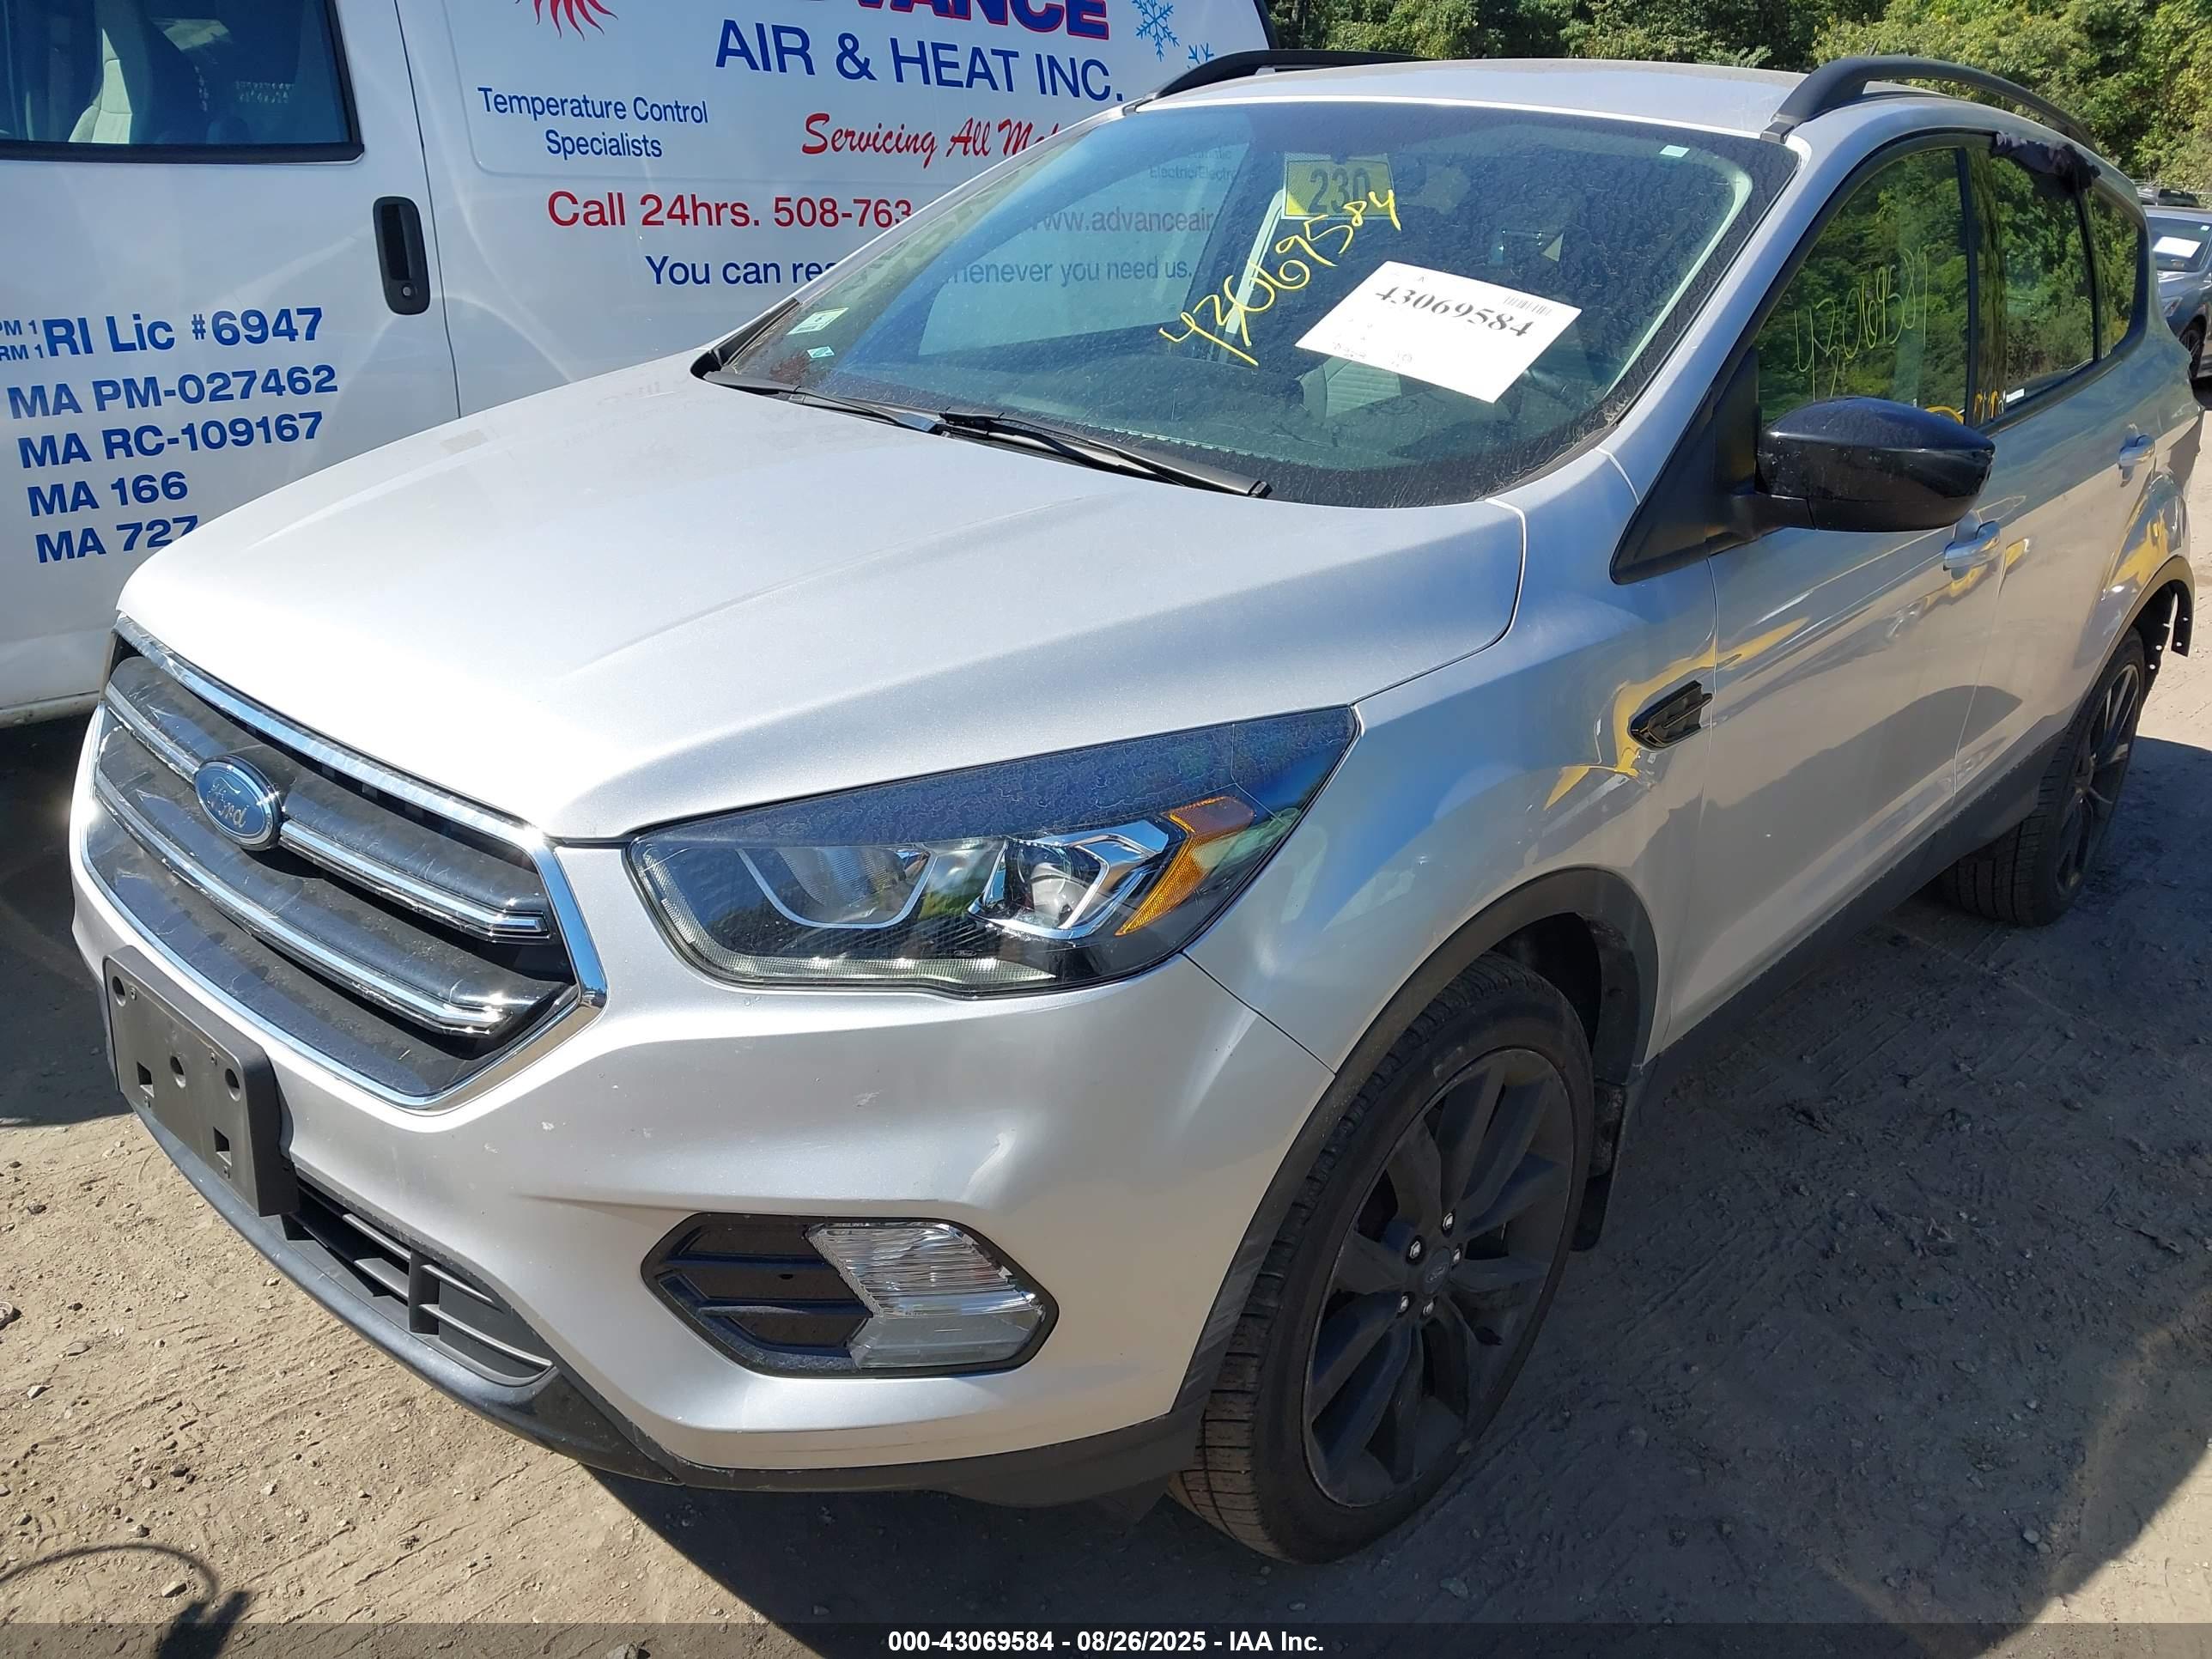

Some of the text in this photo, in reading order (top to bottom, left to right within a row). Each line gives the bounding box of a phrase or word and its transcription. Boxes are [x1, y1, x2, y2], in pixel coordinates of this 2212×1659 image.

[716, 19, 815, 76] AIR
[836, 32, 878, 82] &
[890, 37, 1019, 93] HEAT
[1034, 53, 1123, 102] INC.
[477, 87, 708, 123] Temperature Control
[545, 129, 662, 161] Specialists
[801, 112, 938, 169] Servicing
[945, 117, 992, 156] All
[548, 191, 626, 227] Call
[639, 194, 760, 227] 24hrs.
[1309, 168, 1371, 214] 230
[1031, 206, 1213, 232] ww.advanceair
[646, 255, 710, 285] You
[722, 260, 781, 284] can
[1060, 262, 1100, 288] you
[1107, 257, 1158, 279] need
[1164, 259, 1193, 278] us.
[42, 307, 323, 356] RI Lic #6947
[1375, 284, 1534, 337] 43069584
[7, 364, 338, 419] MA PM-027462
[17, 411, 323, 468] MA RC-109167
[27, 471, 188, 516] MA 166
[35, 527, 106, 563] MA
[206, 776, 248, 829] Ford
